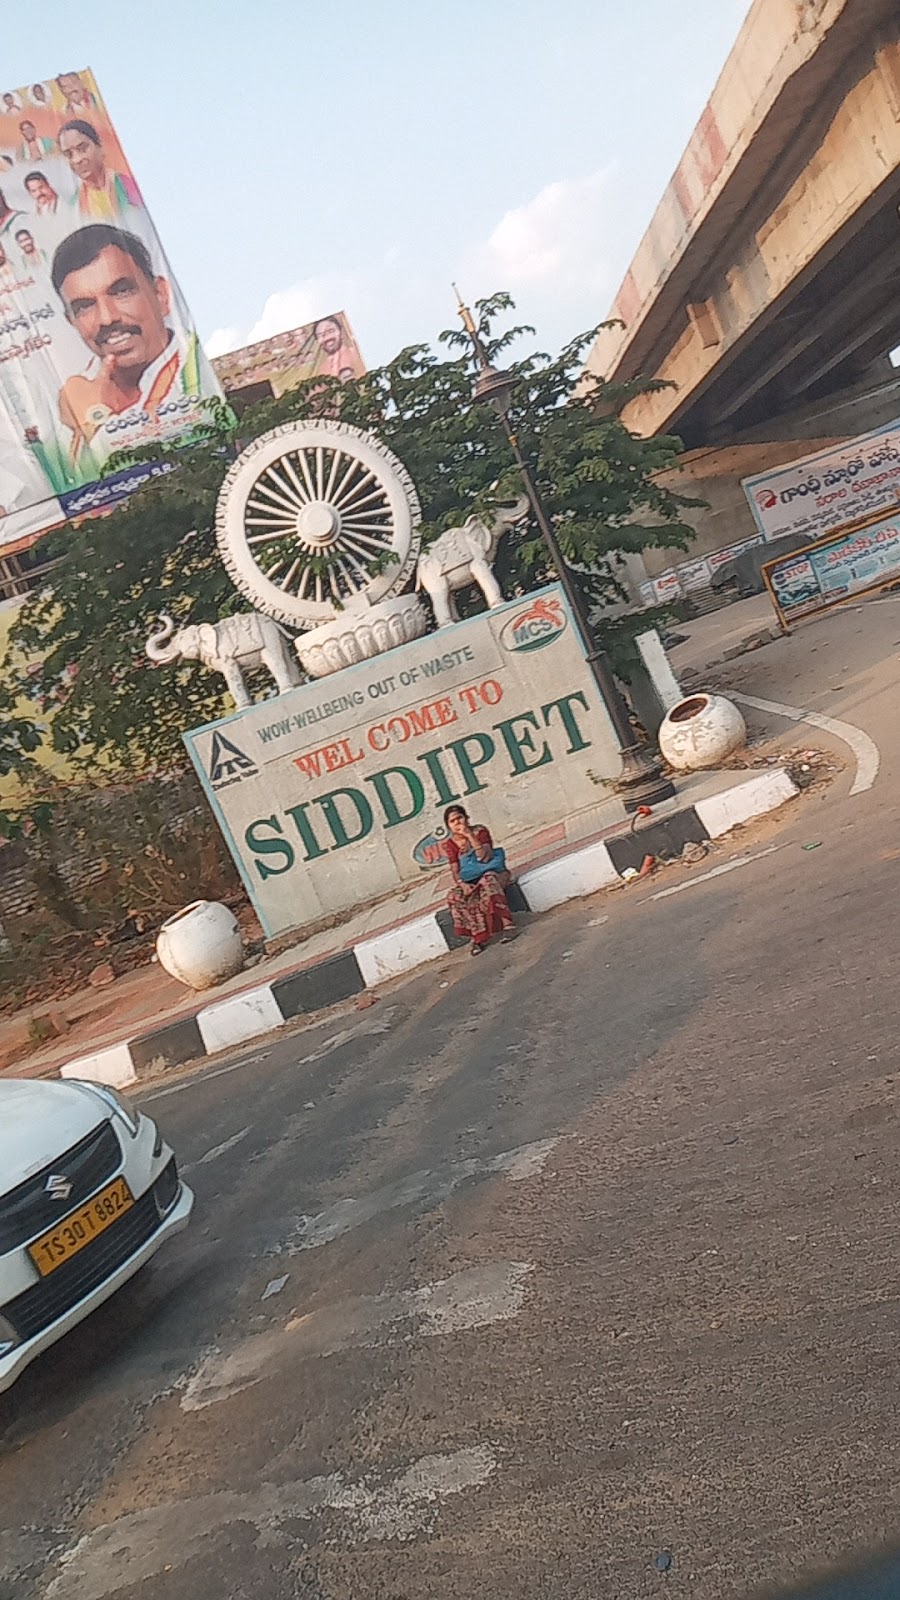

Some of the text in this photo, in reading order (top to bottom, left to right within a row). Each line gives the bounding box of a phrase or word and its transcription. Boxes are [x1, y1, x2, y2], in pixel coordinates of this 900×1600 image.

[513, 618, 551, 645] MCS
[257, 645, 475, 744] WOW-WELLBEING OUT OF WASTE
[293, 678, 504, 781] WEL COME TO
[244, 690, 592, 881] SIDDIPET
